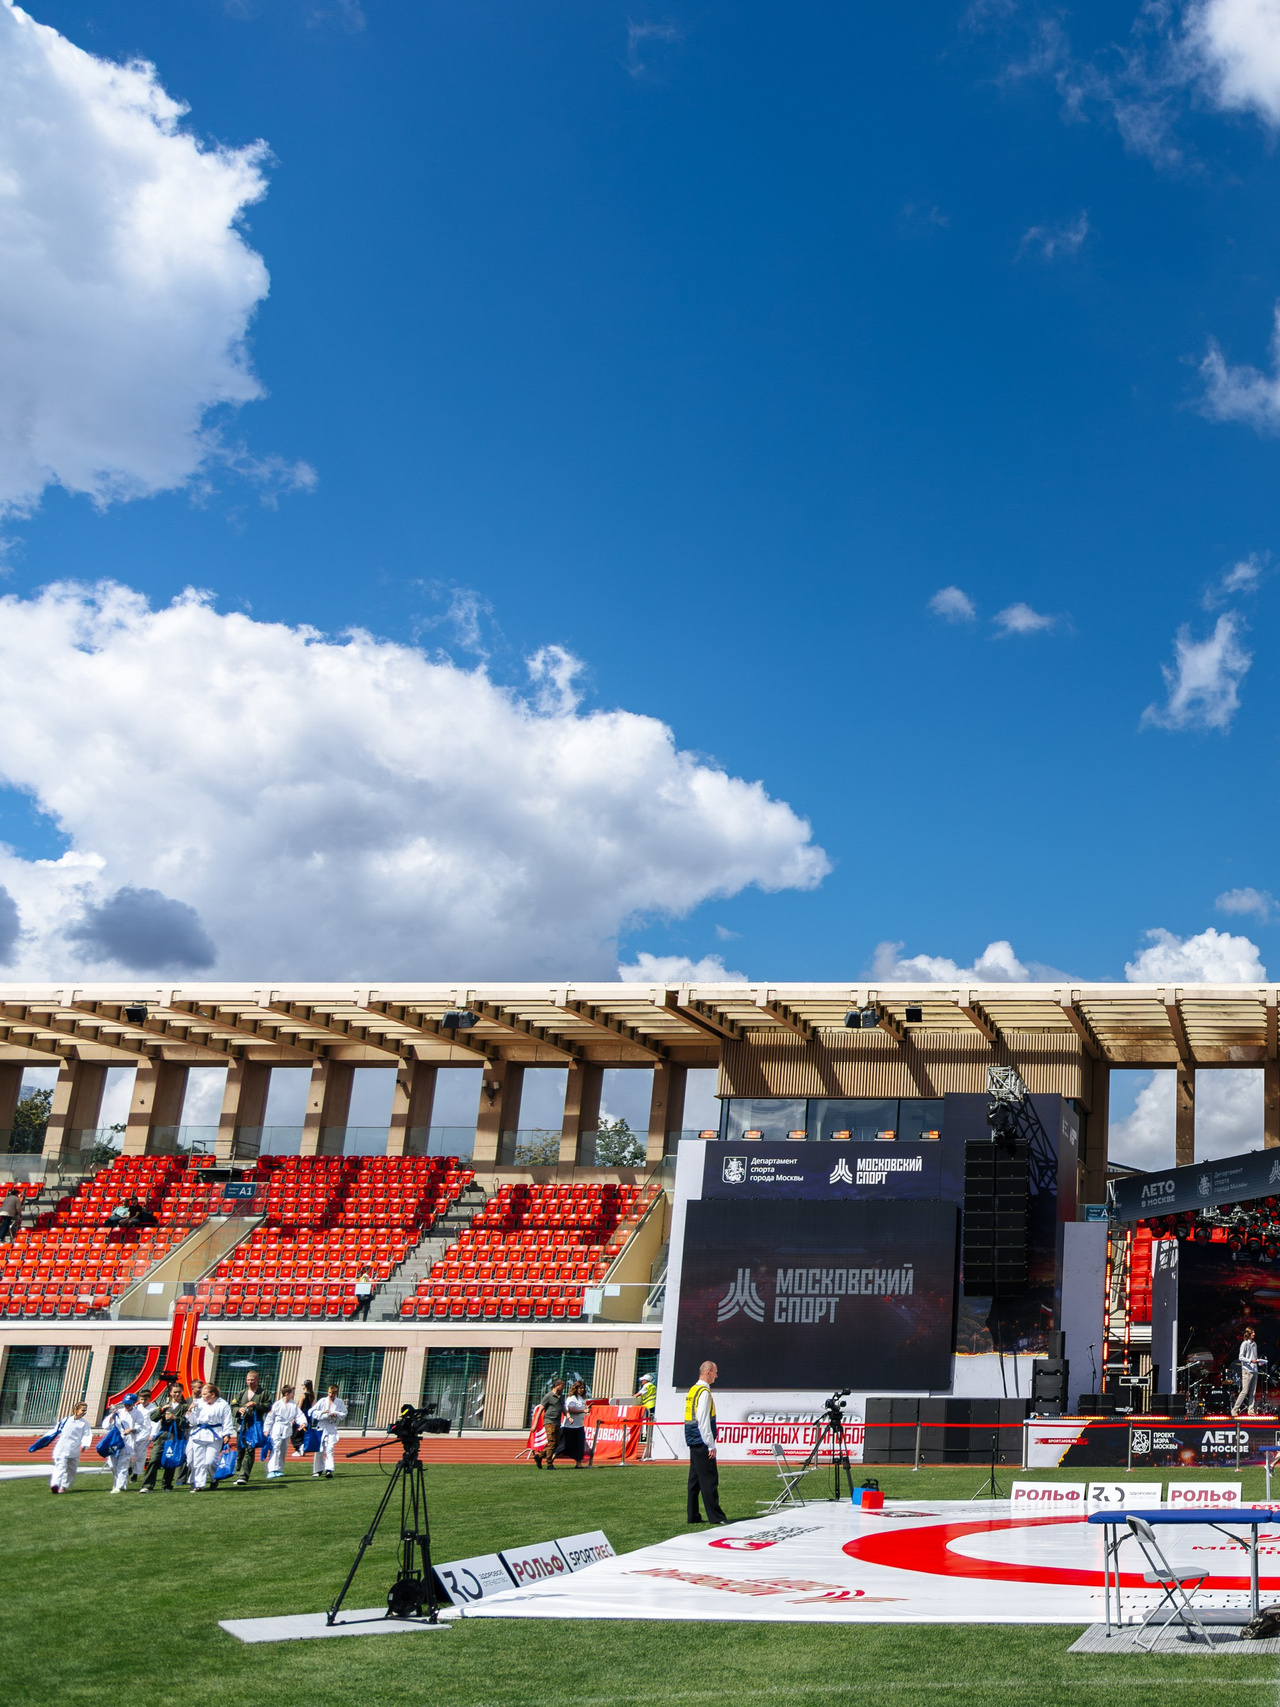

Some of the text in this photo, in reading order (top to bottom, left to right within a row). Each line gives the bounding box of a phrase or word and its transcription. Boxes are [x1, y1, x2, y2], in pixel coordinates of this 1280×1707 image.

[750, 1157, 798, 1166] Департамент
[857, 1156, 922, 1172] МОСКОВСКИЙ
[750, 1166, 775, 1174] спорта
[750, 1174, 804, 1183] города Москвы
[856, 1172, 888, 1185] СПОРТ
[1141, 1180, 1176, 1199] ЛЕТО
[1147, 1196, 1176, 1206] МОСКВЕ
[775, 1263, 914, 1295] МОСКОВСКИЙ
[774, 1297, 840, 1323] СПОРТ
[1201, 1431, 1250, 1444] ЛЕТО
[1201, 1445, 1249, 1453] В МОСКВЕ
[1014, 1489, 1081, 1501] РОЛЬФ
[1171, 1490, 1238, 1502] РОЛЬФ
[569, 1544, 614, 1567] SPORTREC
[512, 1555, 565, 1582] РОЛЬФ
